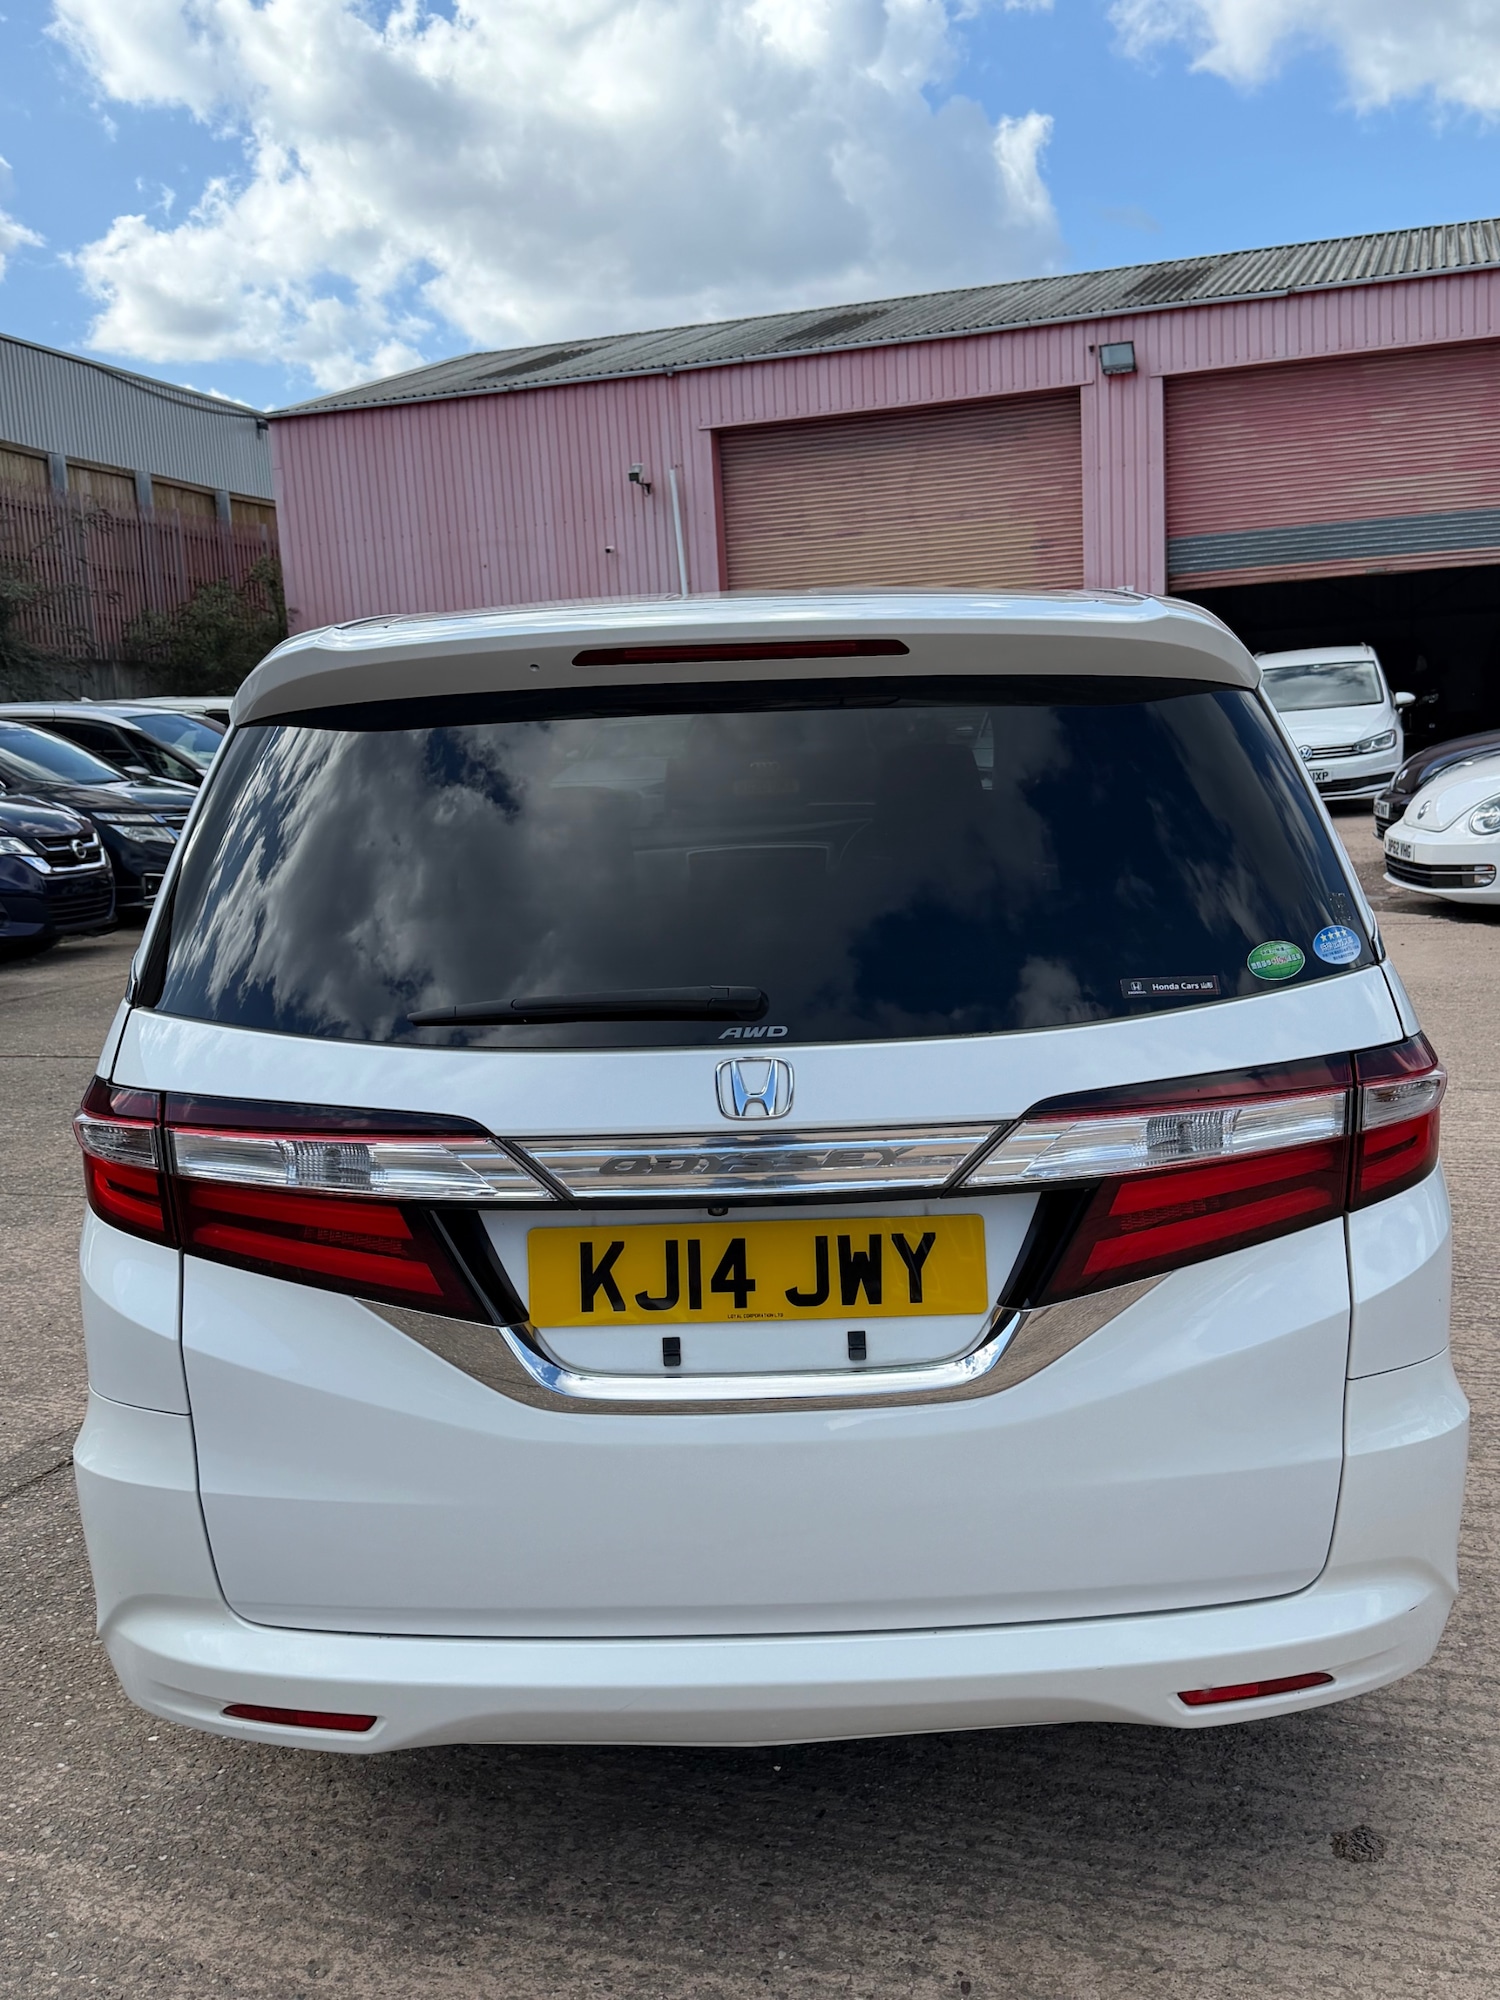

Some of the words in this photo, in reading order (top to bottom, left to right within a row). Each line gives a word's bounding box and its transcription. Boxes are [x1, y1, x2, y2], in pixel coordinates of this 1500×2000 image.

[1152, 983, 1179, 991] Honda
[1180, 982, 1199, 990] Cars
[718, 1025, 788, 1040] AWD
[599, 1145, 916, 1175] ODYSSEY
[580, 1238, 756, 1312] KJ14
[785, 1232, 936, 1307] JWY
